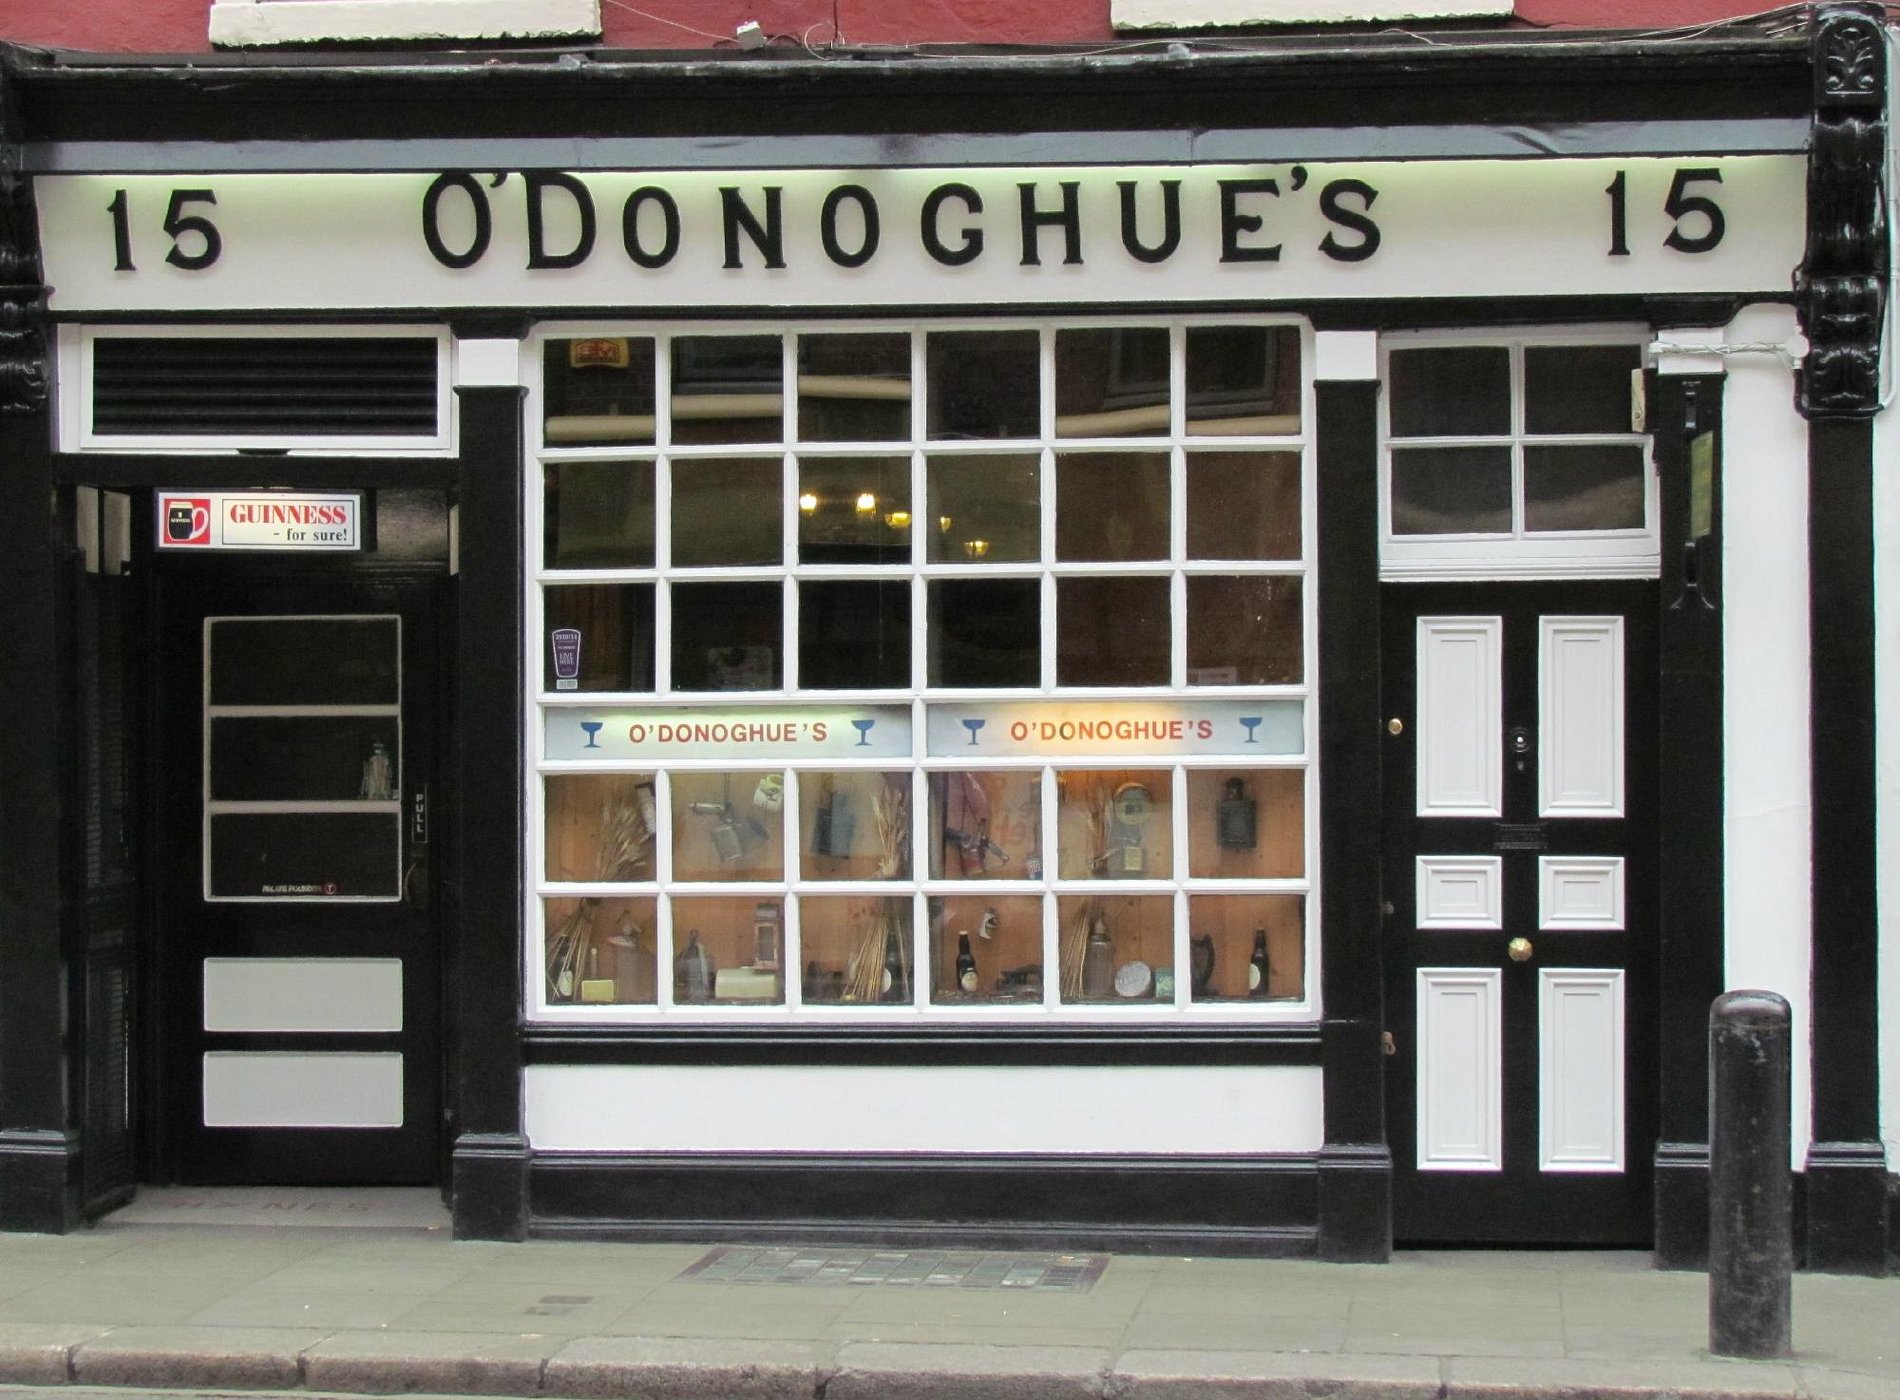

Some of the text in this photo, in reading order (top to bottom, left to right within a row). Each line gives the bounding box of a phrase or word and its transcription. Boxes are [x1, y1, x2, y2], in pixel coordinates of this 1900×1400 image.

[422, 166, 1381, 271] O'DONOGHUE'S
[1604, 167, 1726, 257] 15
[106, 189, 222, 272] 15
[229, 503, 347, 525] GUINNESS
[286, 528, 307, 541] for
[312, 528, 348, 541] sure!
[629, 722, 828, 744] O'DONOGHUE'S
[1010, 719, 1213, 742] O'DONOGHUE'S
[415, 793, 425, 833] PULL
